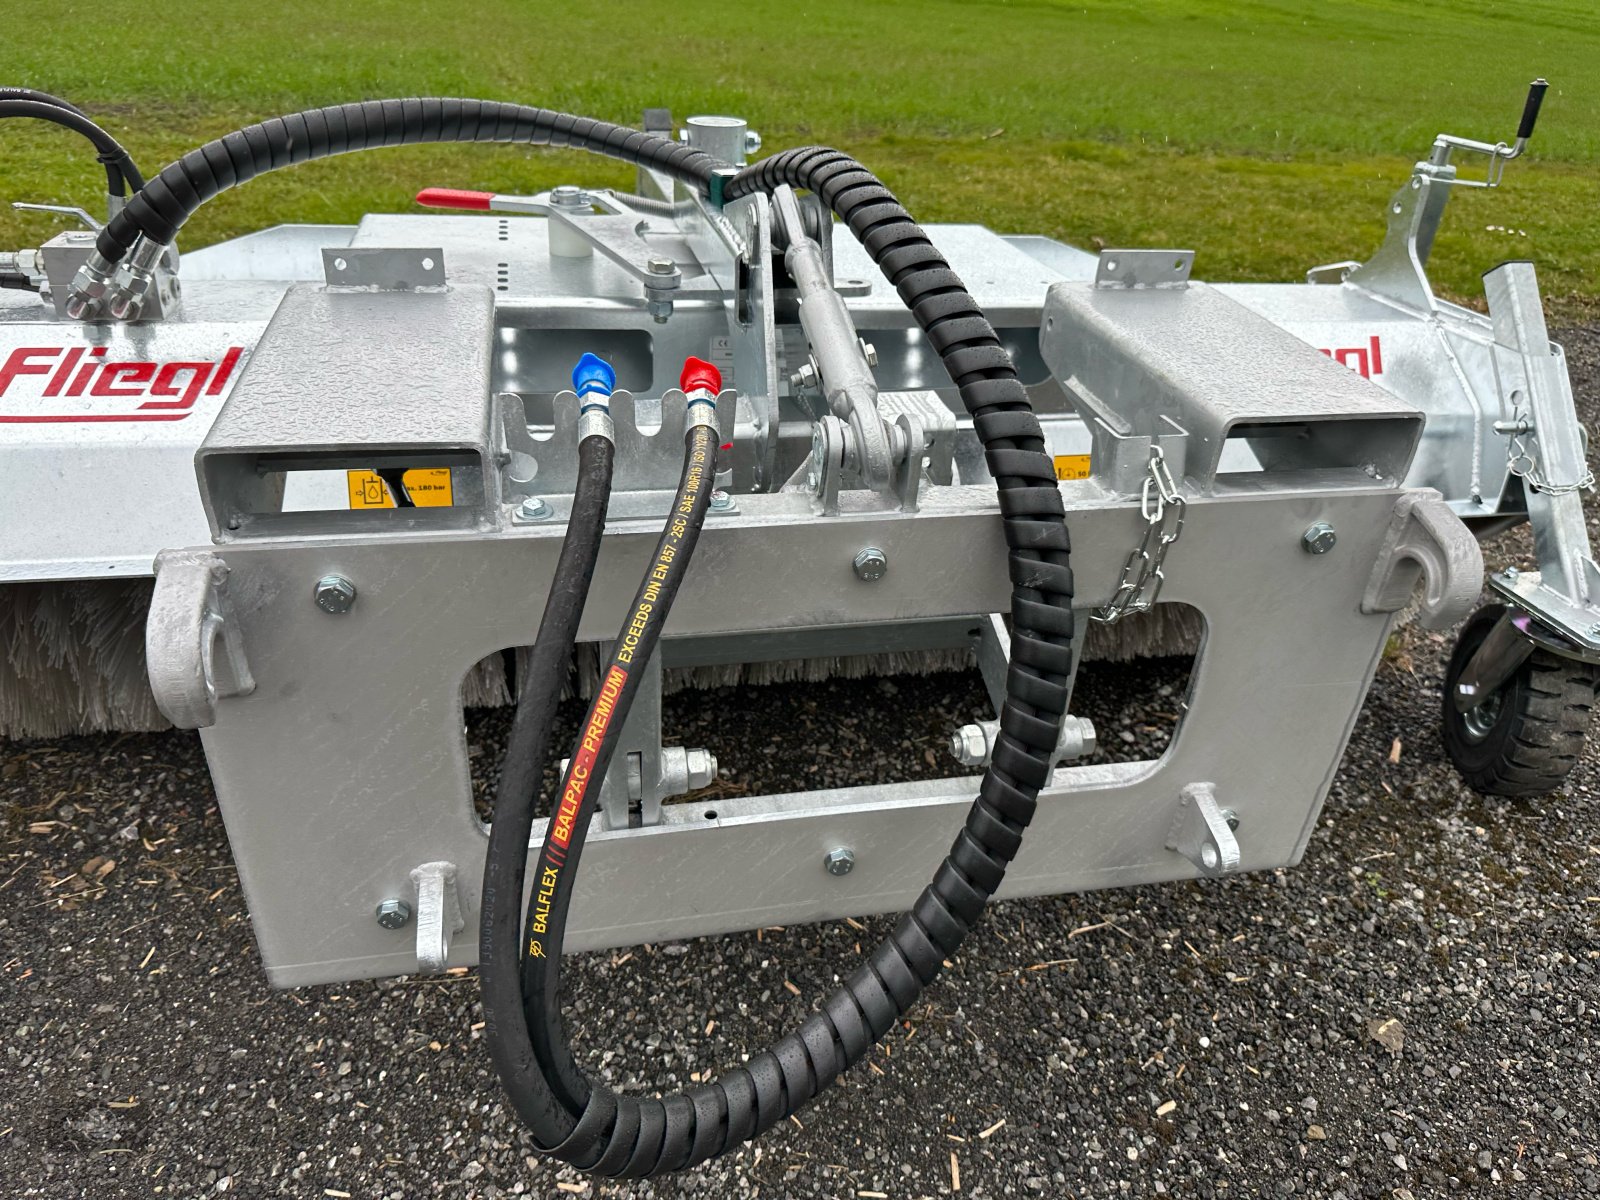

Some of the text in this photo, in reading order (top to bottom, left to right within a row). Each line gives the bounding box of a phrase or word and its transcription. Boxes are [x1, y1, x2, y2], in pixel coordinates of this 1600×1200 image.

[0, 347, 244, 410] Fliegl
[679, 494, 696, 513] SAE
[670, 518, 688, 539] 2SC
[652, 563, 670, 580] EN
[660, 544, 678, 563] 857
[644, 580, 662, 602] DIN
[617, 603, 653, 664] EXCEEDS
[583, 669, 624, 753] PREMIUM
[553, 764, 588, 842] BALPAC
[533, 866, 558, 934] BALFLEX
